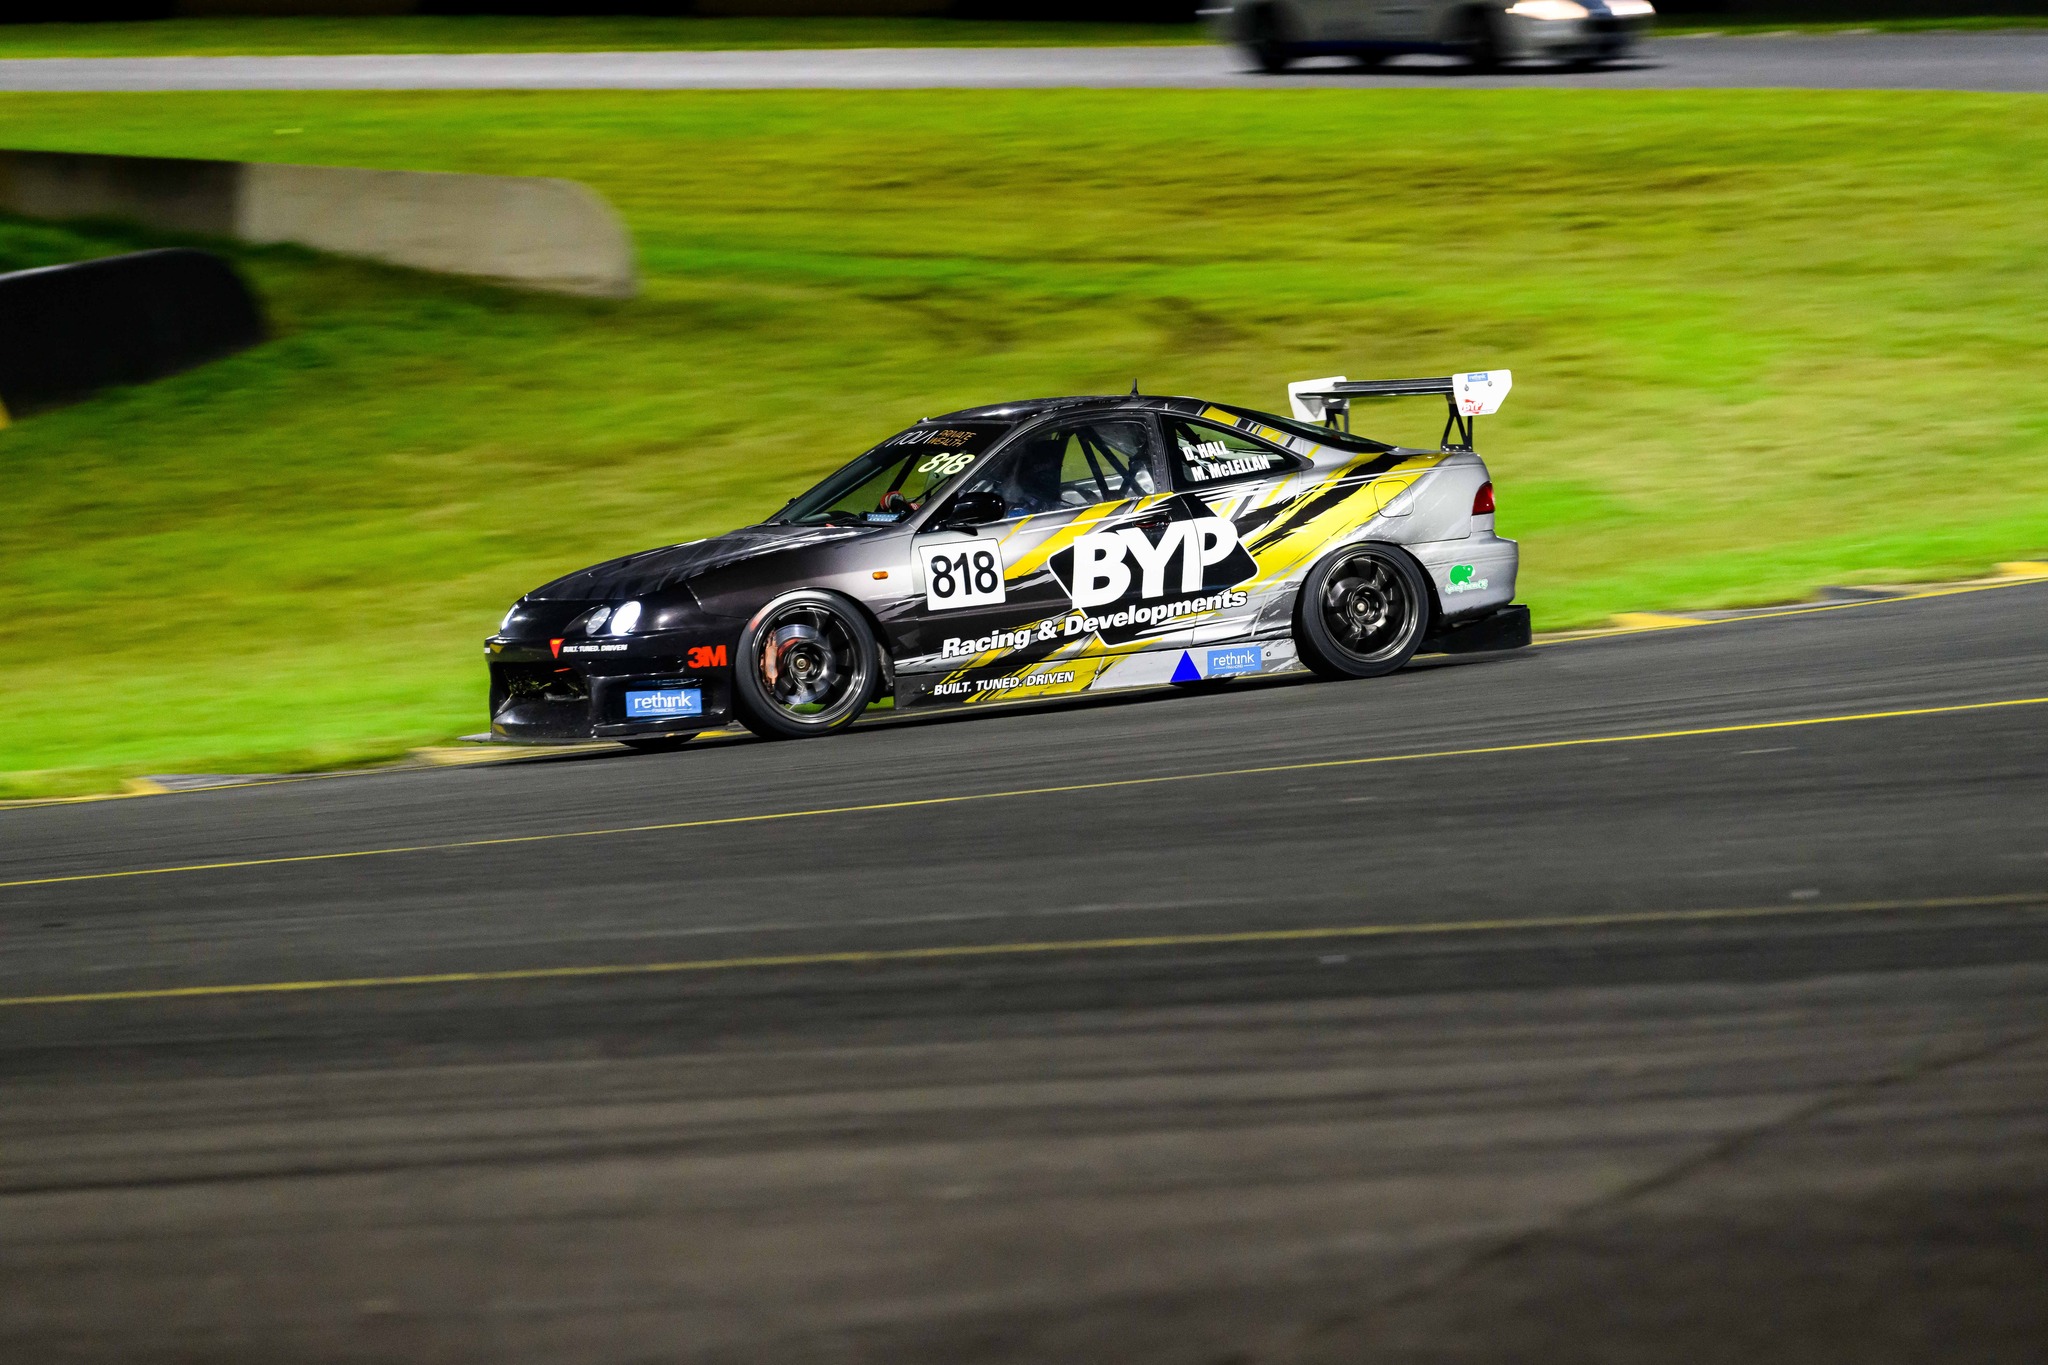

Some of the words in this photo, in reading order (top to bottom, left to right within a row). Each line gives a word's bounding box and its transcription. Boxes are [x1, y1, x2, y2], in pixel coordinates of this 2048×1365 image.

[1182, 446, 1198, 461] D.
[1196, 440, 1230, 459] HALL
[918, 452, 976, 475] 818
[1191, 466, 1209, 482] M.
[1208, 454, 1271, 479] McLELLAN
[931, 550, 999, 599] 818
[1071, 516, 1239, 610] BYP
[942, 628, 1032, 660] Racing
[1037, 619, 1058, 641] &
[1063, 589, 1249, 637] Developments
[687, 644, 728, 669] 3M
[1213, 650, 1255, 667] rethink
[934, 681, 972, 696] BUILT.
[976, 675, 1023, 691] TUNED.
[1026, 670, 1075, 687] DRIVEN
[634, 691, 693, 709] rethink
